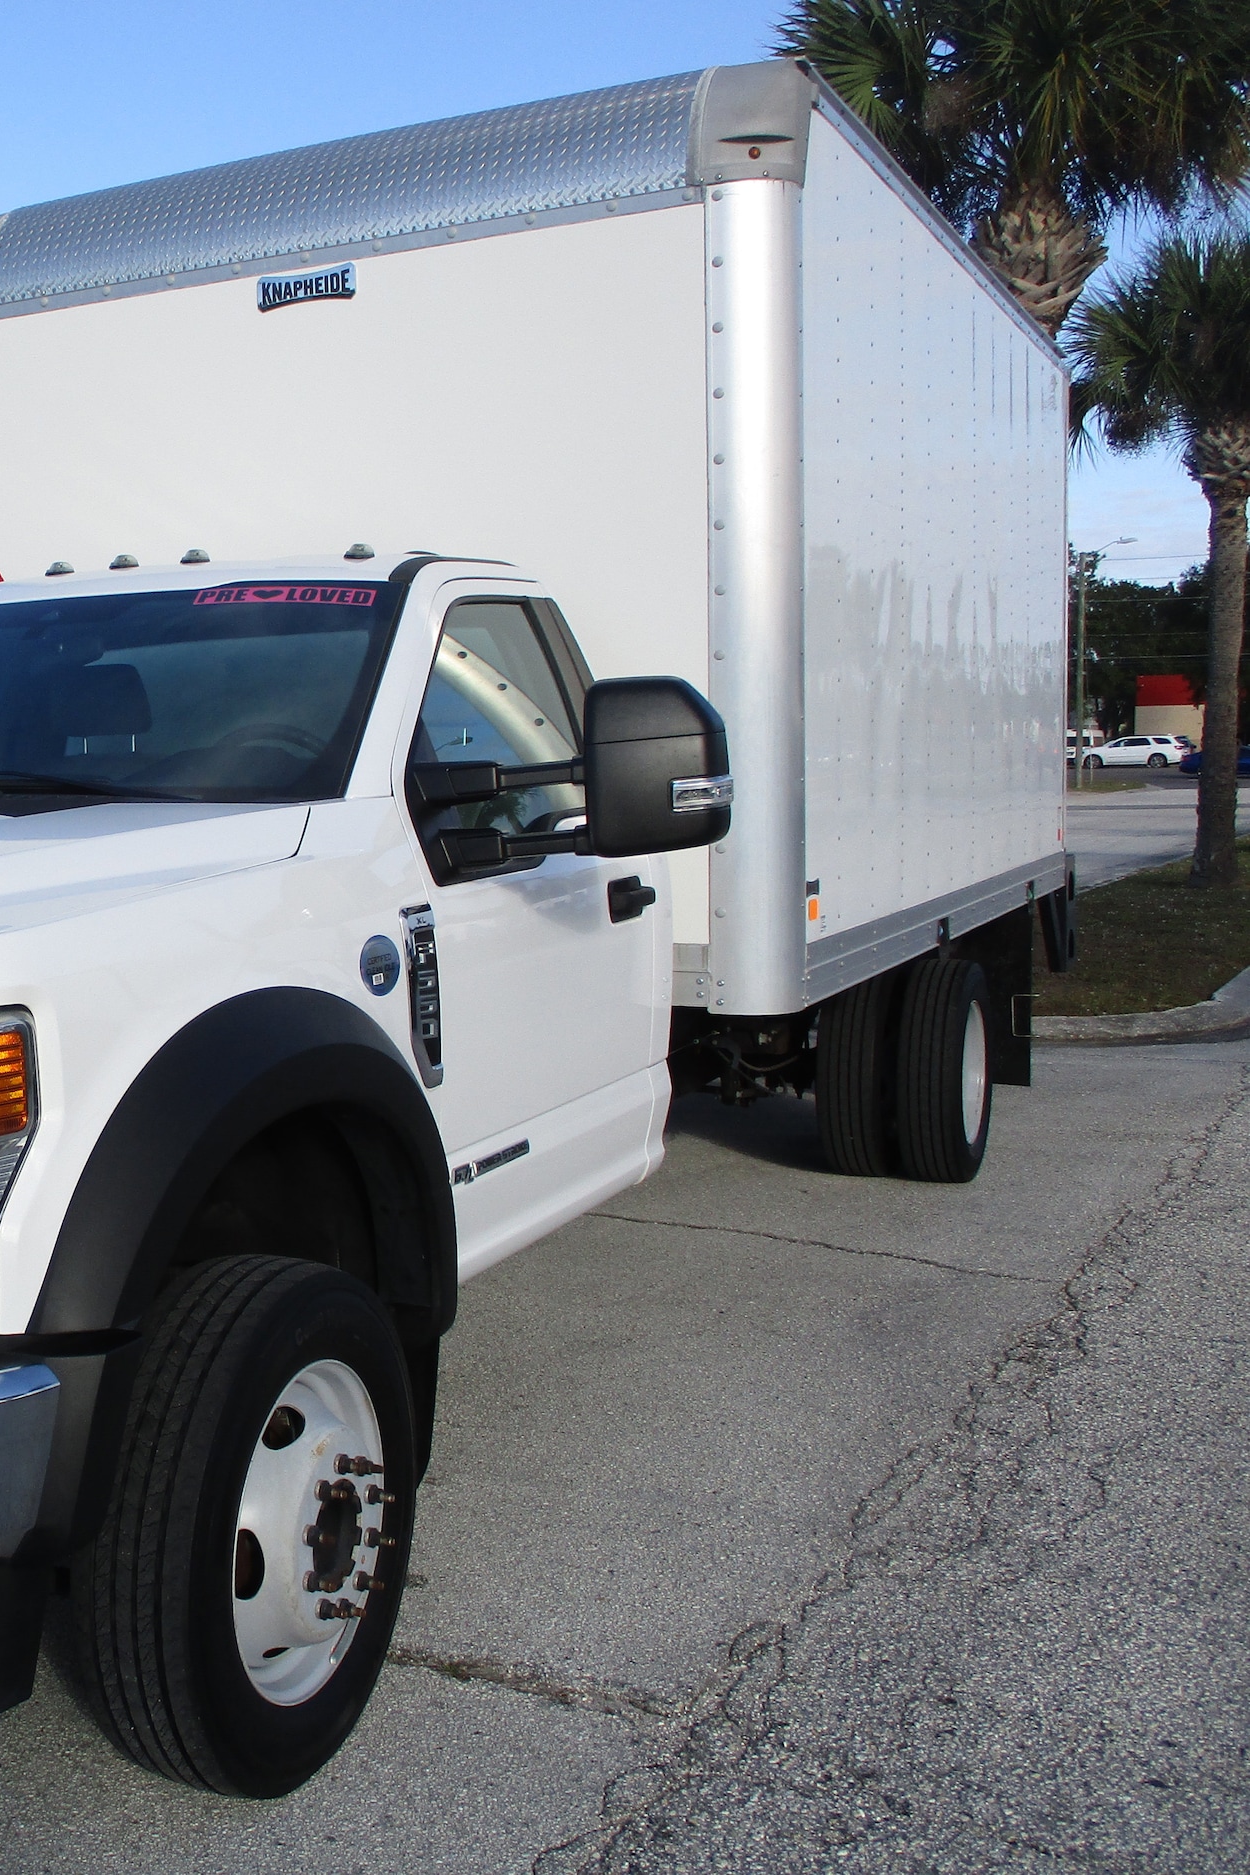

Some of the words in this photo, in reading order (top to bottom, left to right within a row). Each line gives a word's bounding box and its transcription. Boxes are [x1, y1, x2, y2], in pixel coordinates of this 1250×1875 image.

[261, 268, 350, 306] KNAPHEIDE
[199, 588, 251, 603] PRE
[285, 588, 371, 604] LOVED
[416, 916, 426, 925] XL
